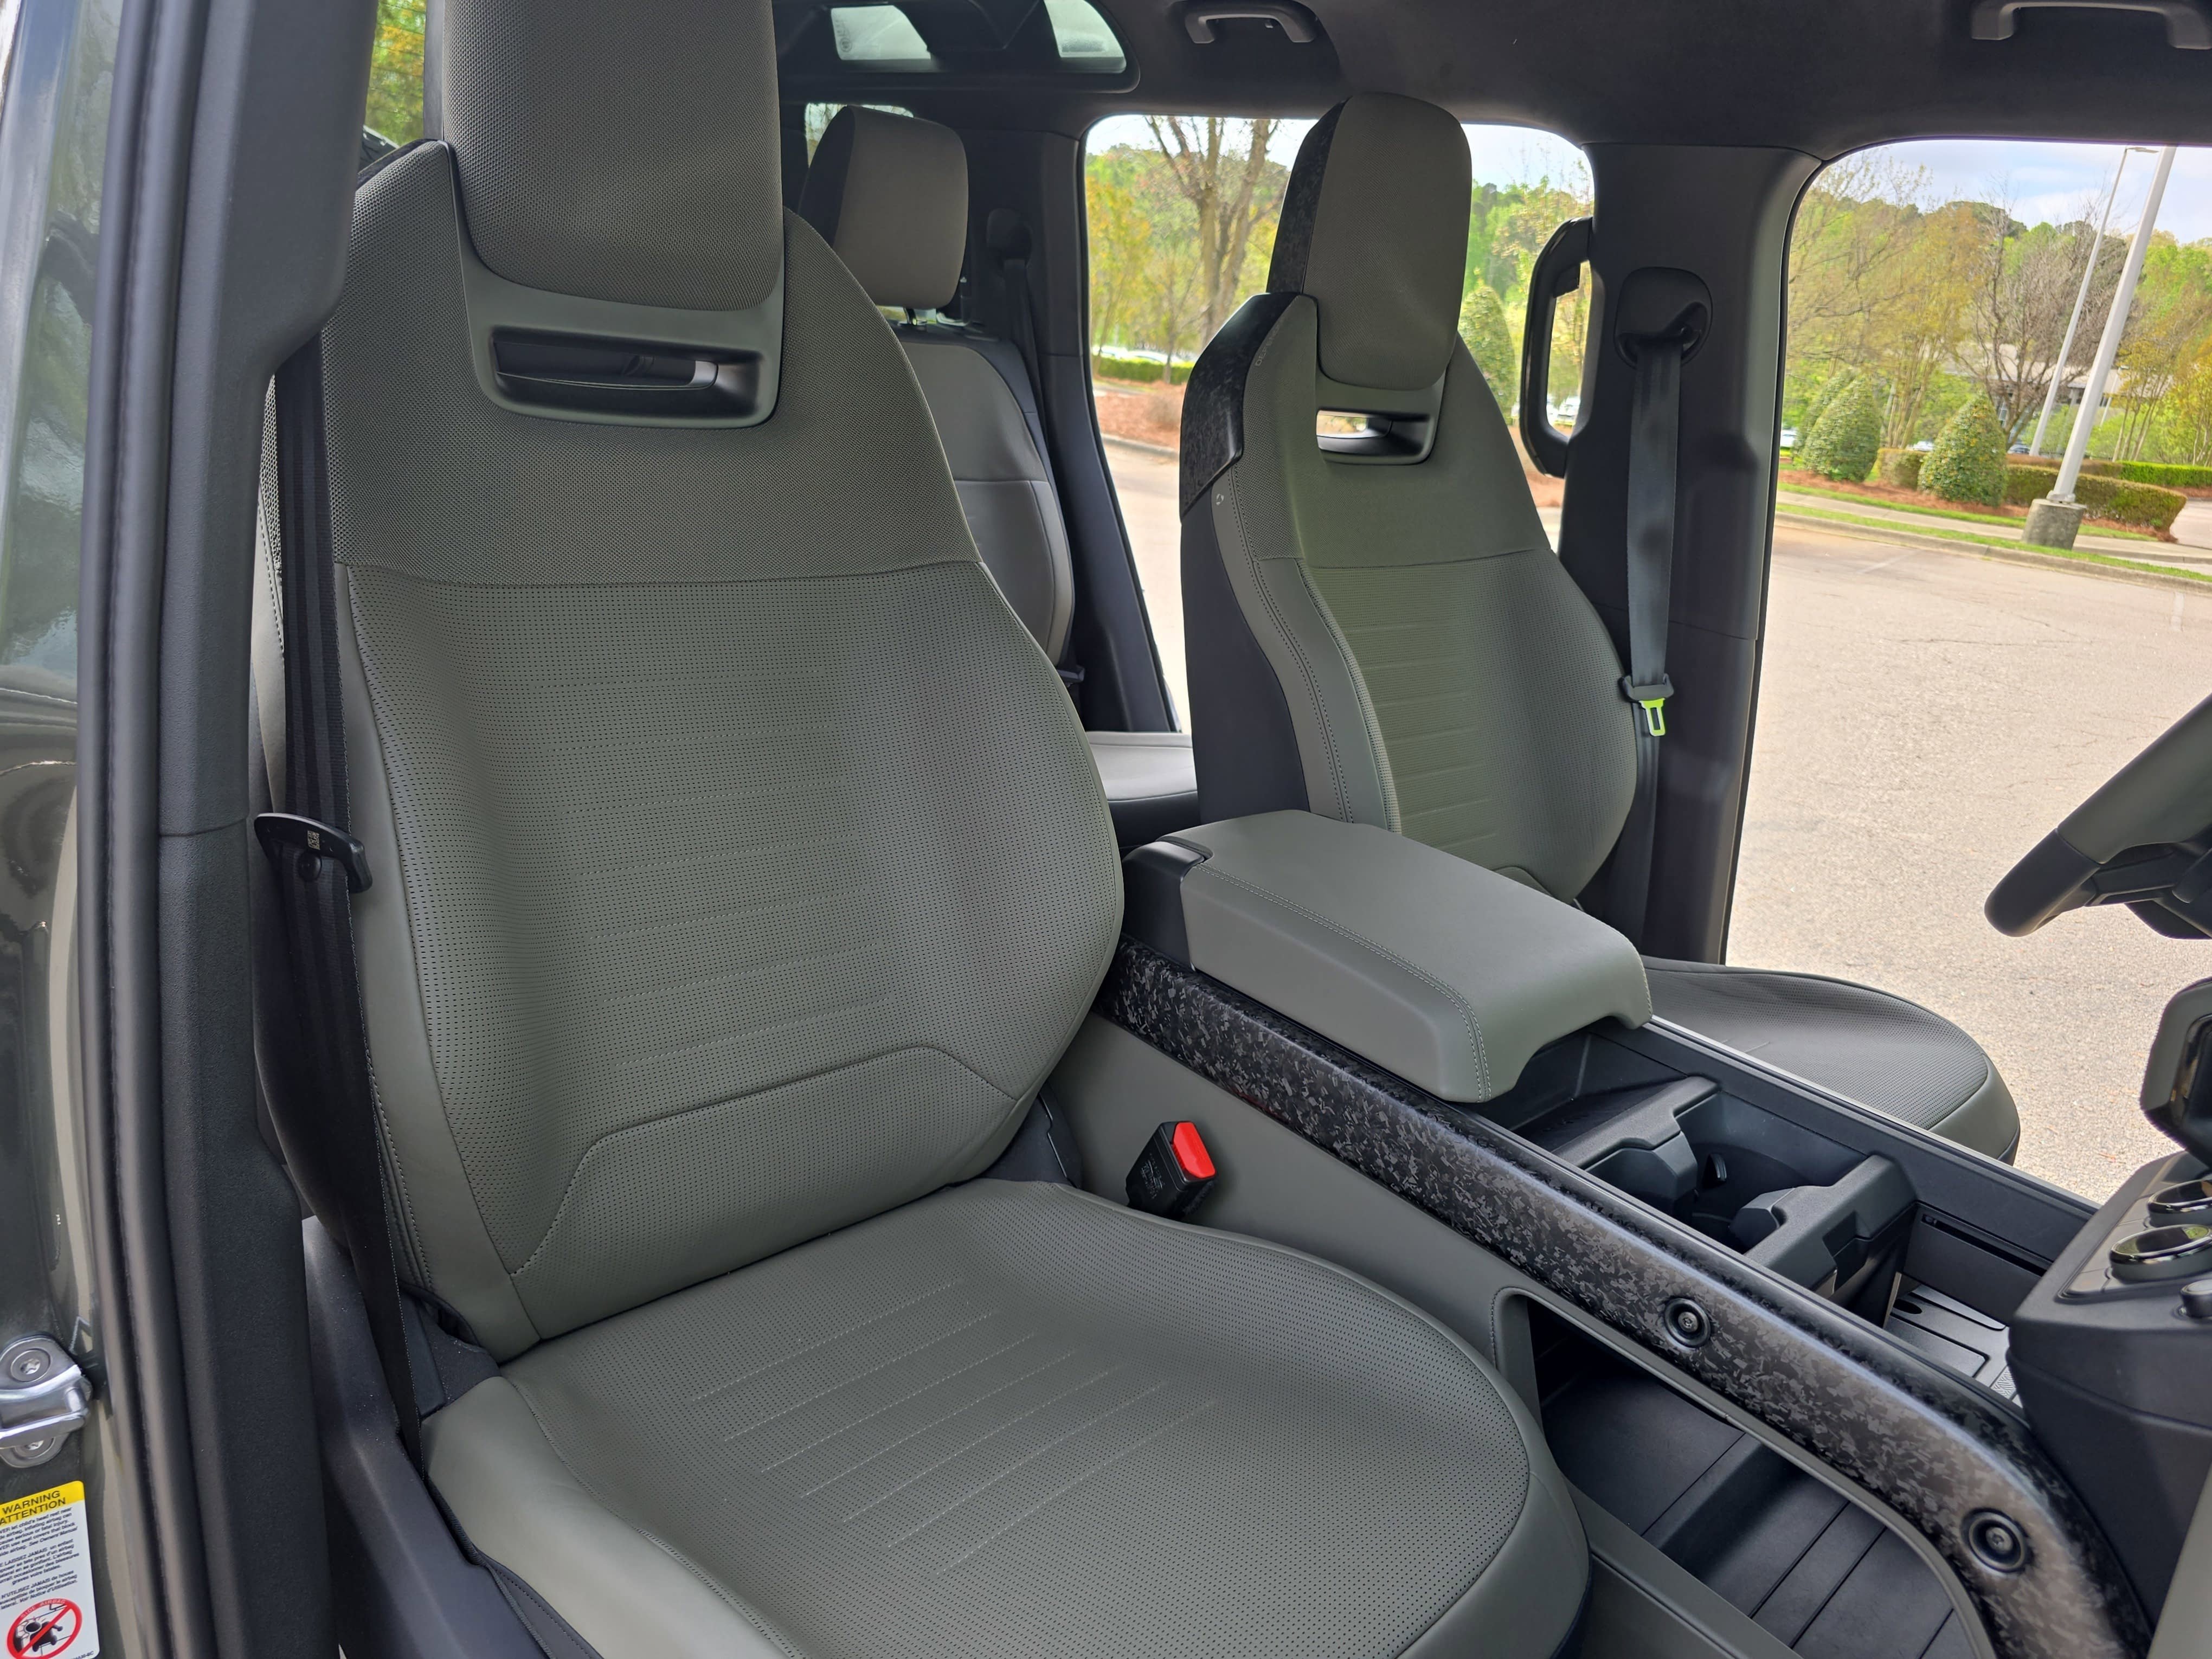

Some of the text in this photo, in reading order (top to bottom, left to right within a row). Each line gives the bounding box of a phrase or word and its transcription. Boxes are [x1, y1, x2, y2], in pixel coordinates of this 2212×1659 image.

[2, 1490, 60, 1514] WARNING
[0, 1497, 66, 1525] ATTENTION
[19, 1520, 35, 1528] child's
[46, 1516, 62, 1524] airbag
[15, 1531, 34, 1540] serious
[33, 1531, 50, 1539] covers
[5, 1554, 27, 1566] LAISSEZ
[28, 1547, 48, 1558] JAMAIS
[58, 1539, 73, 1547] enfant
[59, 1544, 74, 1552] airbag
[55, 1553, 79, 1564] blessures
[12, 1576, 29, 1586] graves
[31, 1578, 50, 1589] JAMAIS
[62, 1574, 78, 1583] airbag
[21, 1606, 35, 1618] SIDE
